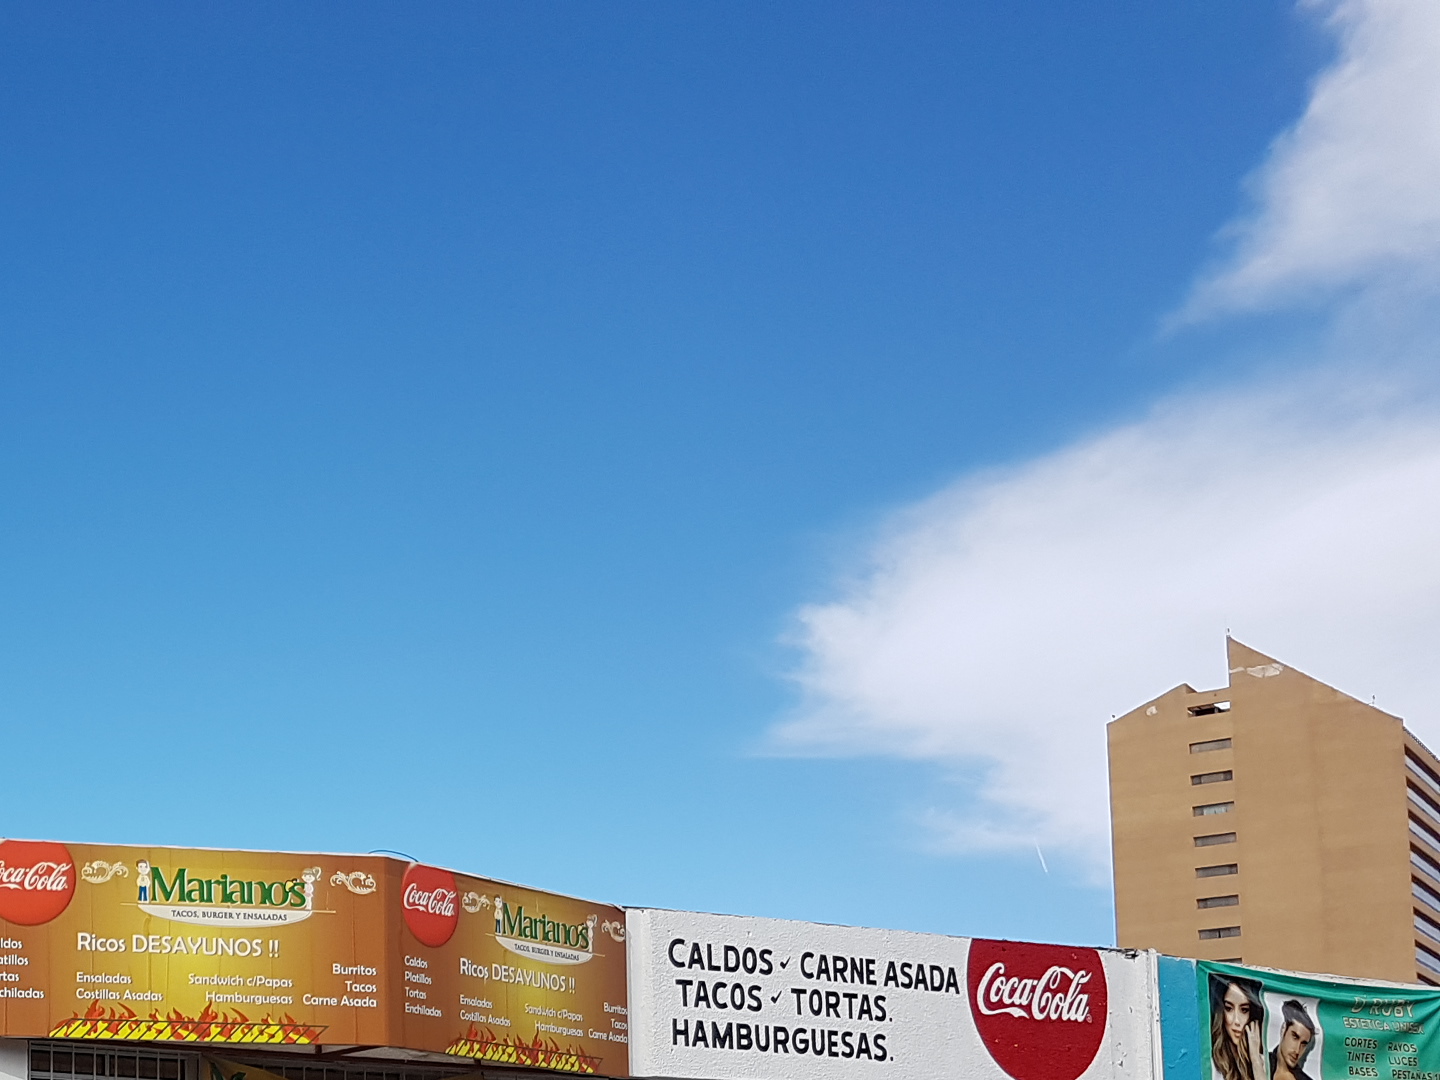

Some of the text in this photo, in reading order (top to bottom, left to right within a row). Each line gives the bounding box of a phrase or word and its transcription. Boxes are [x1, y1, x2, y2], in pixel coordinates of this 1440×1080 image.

[403, 883, 456, 916] Coca-Cola
[202, 911, 234, 920] BURGER
[235, 912, 241, 920] Y
[243, 912, 287, 922] ENSALADAS
[76, 932, 126, 952] Ricos
[132, 934, 262, 956] DESAYUNOS
[404, 955, 428, 969] Caldos
[668, 938, 961, 995] CALDOS CARNE ASADA
[332, 963, 377, 976] Burritos
[460, 957, 489, 979] Ricos
[492, 963, 566, 992] DESAYUNOS
[76, 972, 132, 984] Ensaladas
[188, 973, 293, 990] Sandwich c/Papas
[404, 971, 432, 985] Platillos
[345, 980, 377, 992] Tacos
[976, 962, 1092, 1022] Coca-Cola
[76, 988, 163, 1001] Costillas Asadas
[205, 991, 293, 1005] Hamburguesas
[303, 993, 377, 1008] Carne Asada
[404, 987, 427, 1000] Tortas
[459, 994, 493, 1009] Ensaladas
[675, 979, 894, 1023] TACOS TORTAS.
[404, 1003, 442, 1017] Enchiladas
[524, 1003, 556, 1018] Sandwich
[603, 1002, 628, 1016] Burritos
[459, 1010, 511, 1027] Costillas Asadas
[610, 1018, 628, 1030] Tacos
[534, 1020, 584, 1037] Hamburguesas
[588, 1028, 628, 1043] Carne Asada
[671, 1017, 895, 1062] HAMBURGUESAS.
[1344, 1037, 1378, 1050] CORTES
[1387, 1042, 1418, 1053] RAYOS
[1347, 1051, 1376, 1063] TINTES
[1388, 1056, 1418, 1067] LUCES
[1348, 1066, 1378, 1077] BASES
